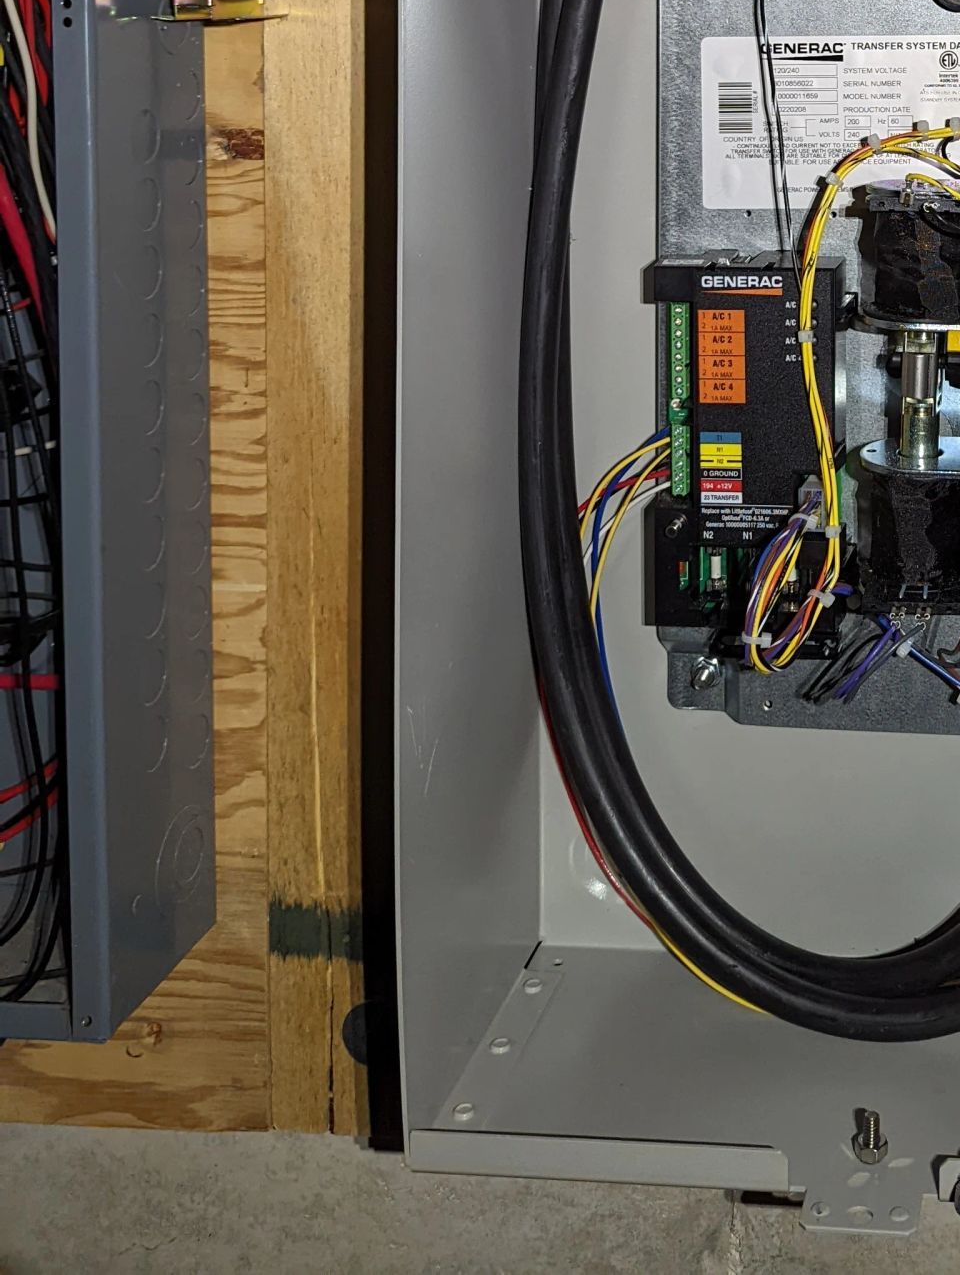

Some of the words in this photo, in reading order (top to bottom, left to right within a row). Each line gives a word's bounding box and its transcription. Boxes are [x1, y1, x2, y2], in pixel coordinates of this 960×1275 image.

[760, 43, 844, 54] GENERAC
[851, 42, 903, 50] TRANSFER
[906, 42, 946, 50] SYSTEM
[701, 276, 783, 287] GENERAC
[713, 383, 725, 391] A/C
[704, 531, 714, 539] N2
[742, 531, 752, 540] N1
